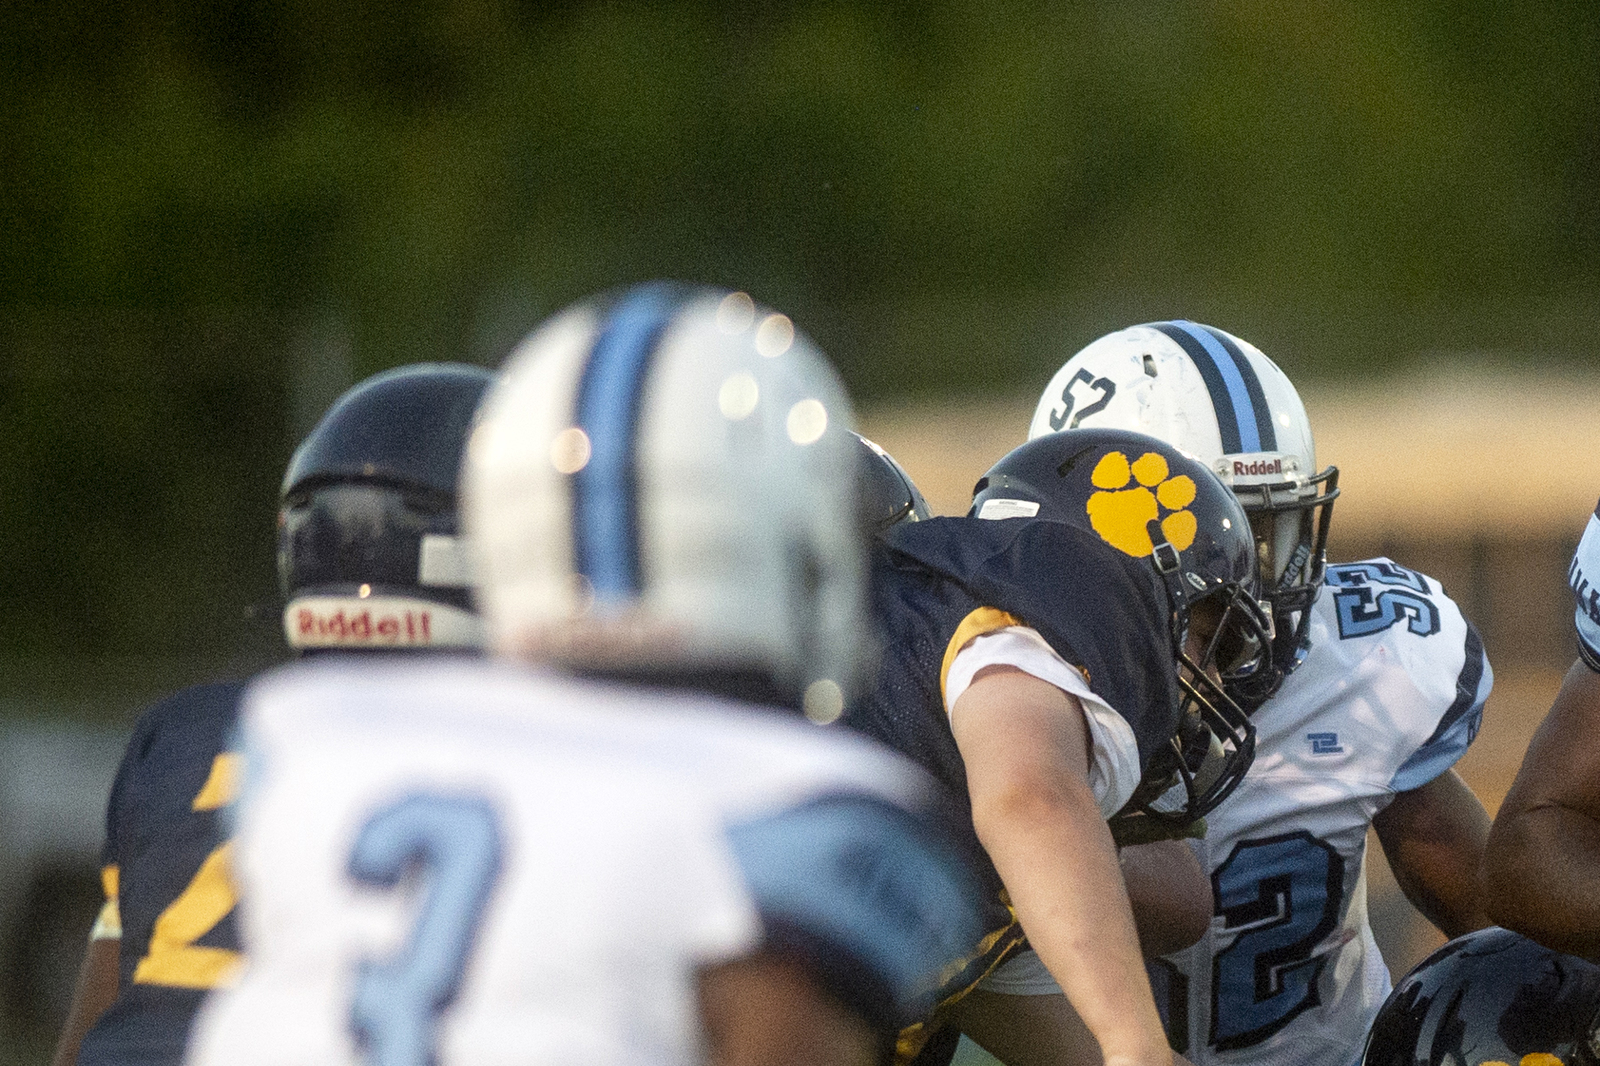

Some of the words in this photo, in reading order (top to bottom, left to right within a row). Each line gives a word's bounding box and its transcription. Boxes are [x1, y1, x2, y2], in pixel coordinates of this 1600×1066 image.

[1049, 368, 1116, 432] 52
[1233, 459, 1283, 478] Riddell
[298, 608, 432, 643] Riddell
[1325, 558, 1442, 640] 52
[1147, 828, 1346, 1055] 2
